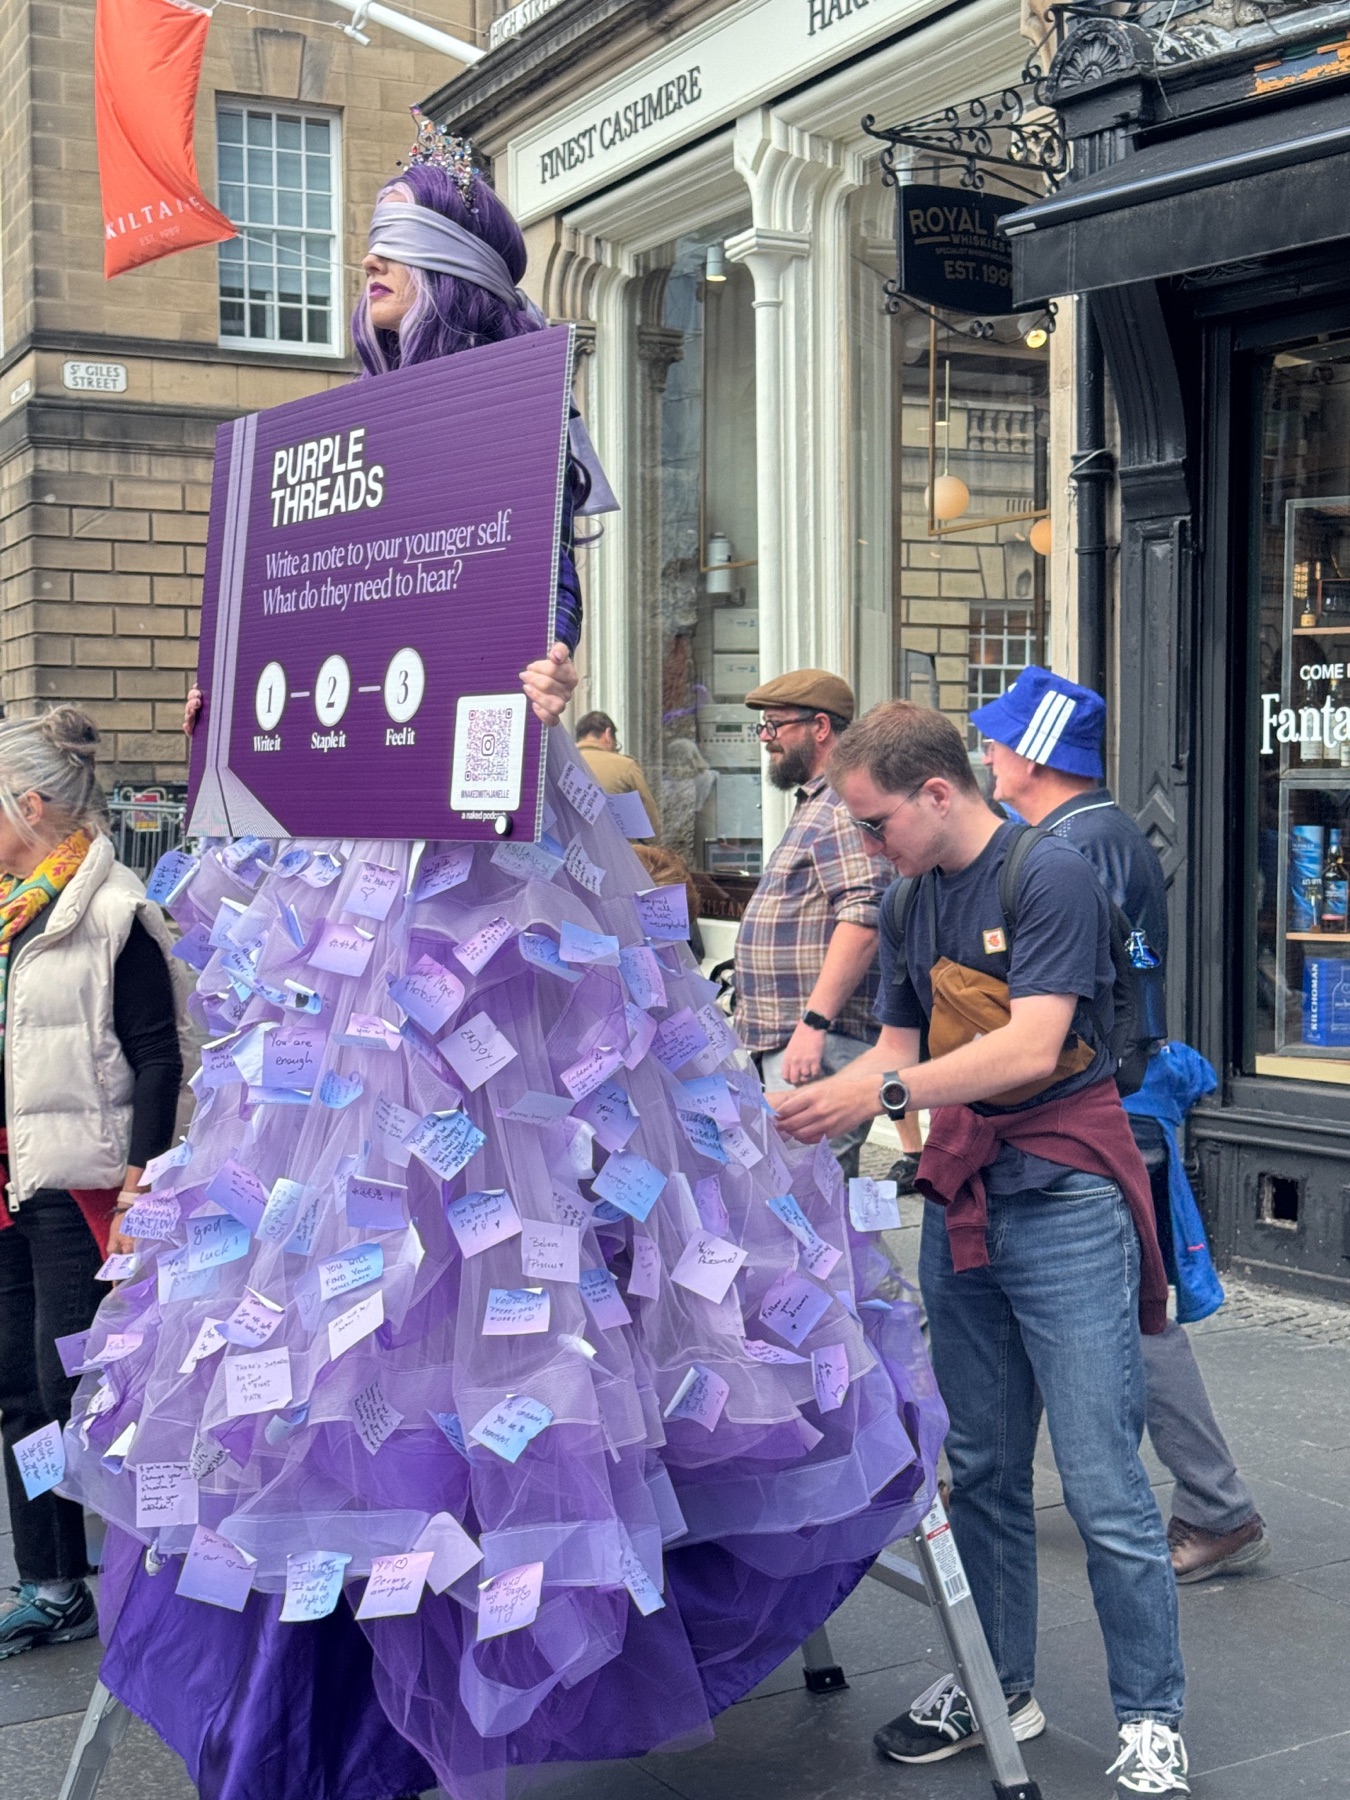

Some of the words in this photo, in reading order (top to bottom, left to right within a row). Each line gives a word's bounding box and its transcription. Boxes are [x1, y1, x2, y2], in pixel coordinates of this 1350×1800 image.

[540, 123, 600, 185] FINEST
[599, 65, 703, 150] CASHMERE
[909, 207, 988, 234] ROYAL
[951, 234, 1005, 251] WHISKIES
[944, 260, 980, 281] EST.
[85, 365, 120, 378] GILES
[72, 376, 119, 389] STREET
[272, 428, 365, 488] PURPLE
[271, 465, 384, 527] THREADS
[266, 551, 299, 580] Write
[301, 557, 310, 574] a
[313, 546, 345, 571] note
[347, 542, 363, 565] to
[365, 539, 403, 571] your
[404, 524, 474, 557] younger
[477, 509, 512, 545] self.
[263, 585, 297, 616] What
[299, 582, 318, 611] do
[320, 576, 352, 612] they
[354, 568, 392, 603] need
[396, 572, 412, 596] to
[416, 560, 463, 594] hear?
[1299, 664, 1344, 681] COME
[325, 676, 338, 708] 2
[396, 669, 410, 706] 3
[266, 685, 274, 714] 1
[253, 735, 273, 752] Write
[274, 736, 281, 750] it
[311, 732, 337, 753] Staple
[338, 731, 346, 748] it
[386, 728, 406, 746] Feel
[406, 727, 415, 745] it
[466, 811, 483, 820] naked
[1310, 963, 1319, 1031] KILCHOMAN
[271, 1032, 286, 1047] You
[293, 1039, 312, 1047] are
[275, 1051, 313, 1071] enough
[193, 1218, 222, 1246] good
[326, 1262, 343, 1274] YOU
[326, 1274, 346, 1286] FIND
[141, 1474, 165, 1484] Change
[168, 1473, 181, 1483] your
[141, 1495, 163, 1505] change
[166, 1495, 179, 1504] your
